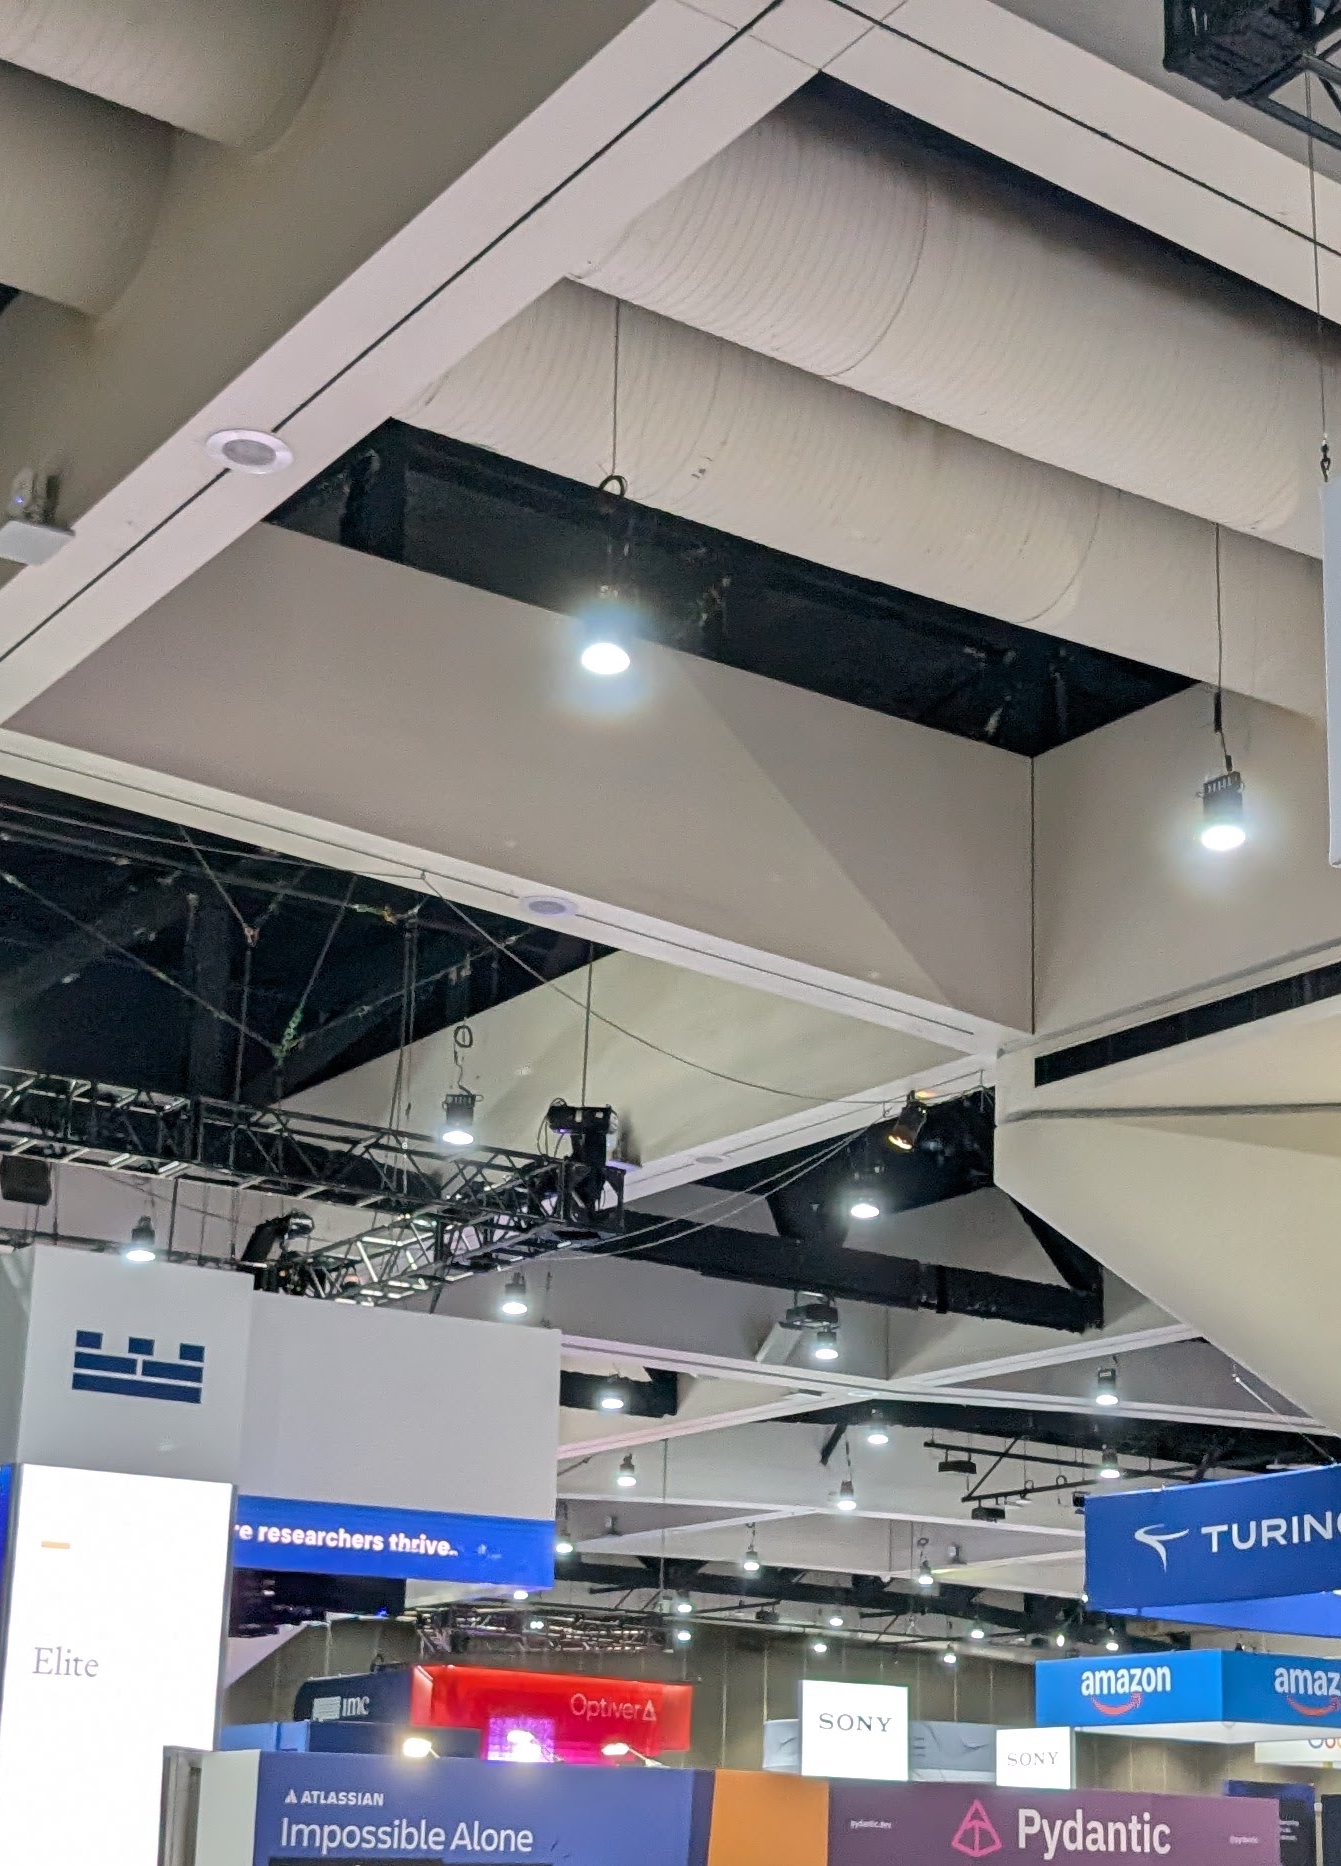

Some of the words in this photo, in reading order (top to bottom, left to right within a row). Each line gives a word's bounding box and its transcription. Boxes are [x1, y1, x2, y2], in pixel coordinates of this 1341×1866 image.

[258, 1525, 384, 1551] researchers
[389, 1533, 458, 1557] thrive.
[32, 1646, 99, 1677] Elite
[1081, 1665, 1172, 1697] amazon
[570, 1692, 642, 1721] Optiver
[819, 1712, 892, 1732] SONY
[1007, 1751, 1059, 1767] SONY
[300, 1790, 385, 1807] ATLASSIAN
[280, 1817, 446, 1856] Impossible
[450, 1820, 534, 1853] Alone
[1018, 1808, 1172, 1861] Pydantic
